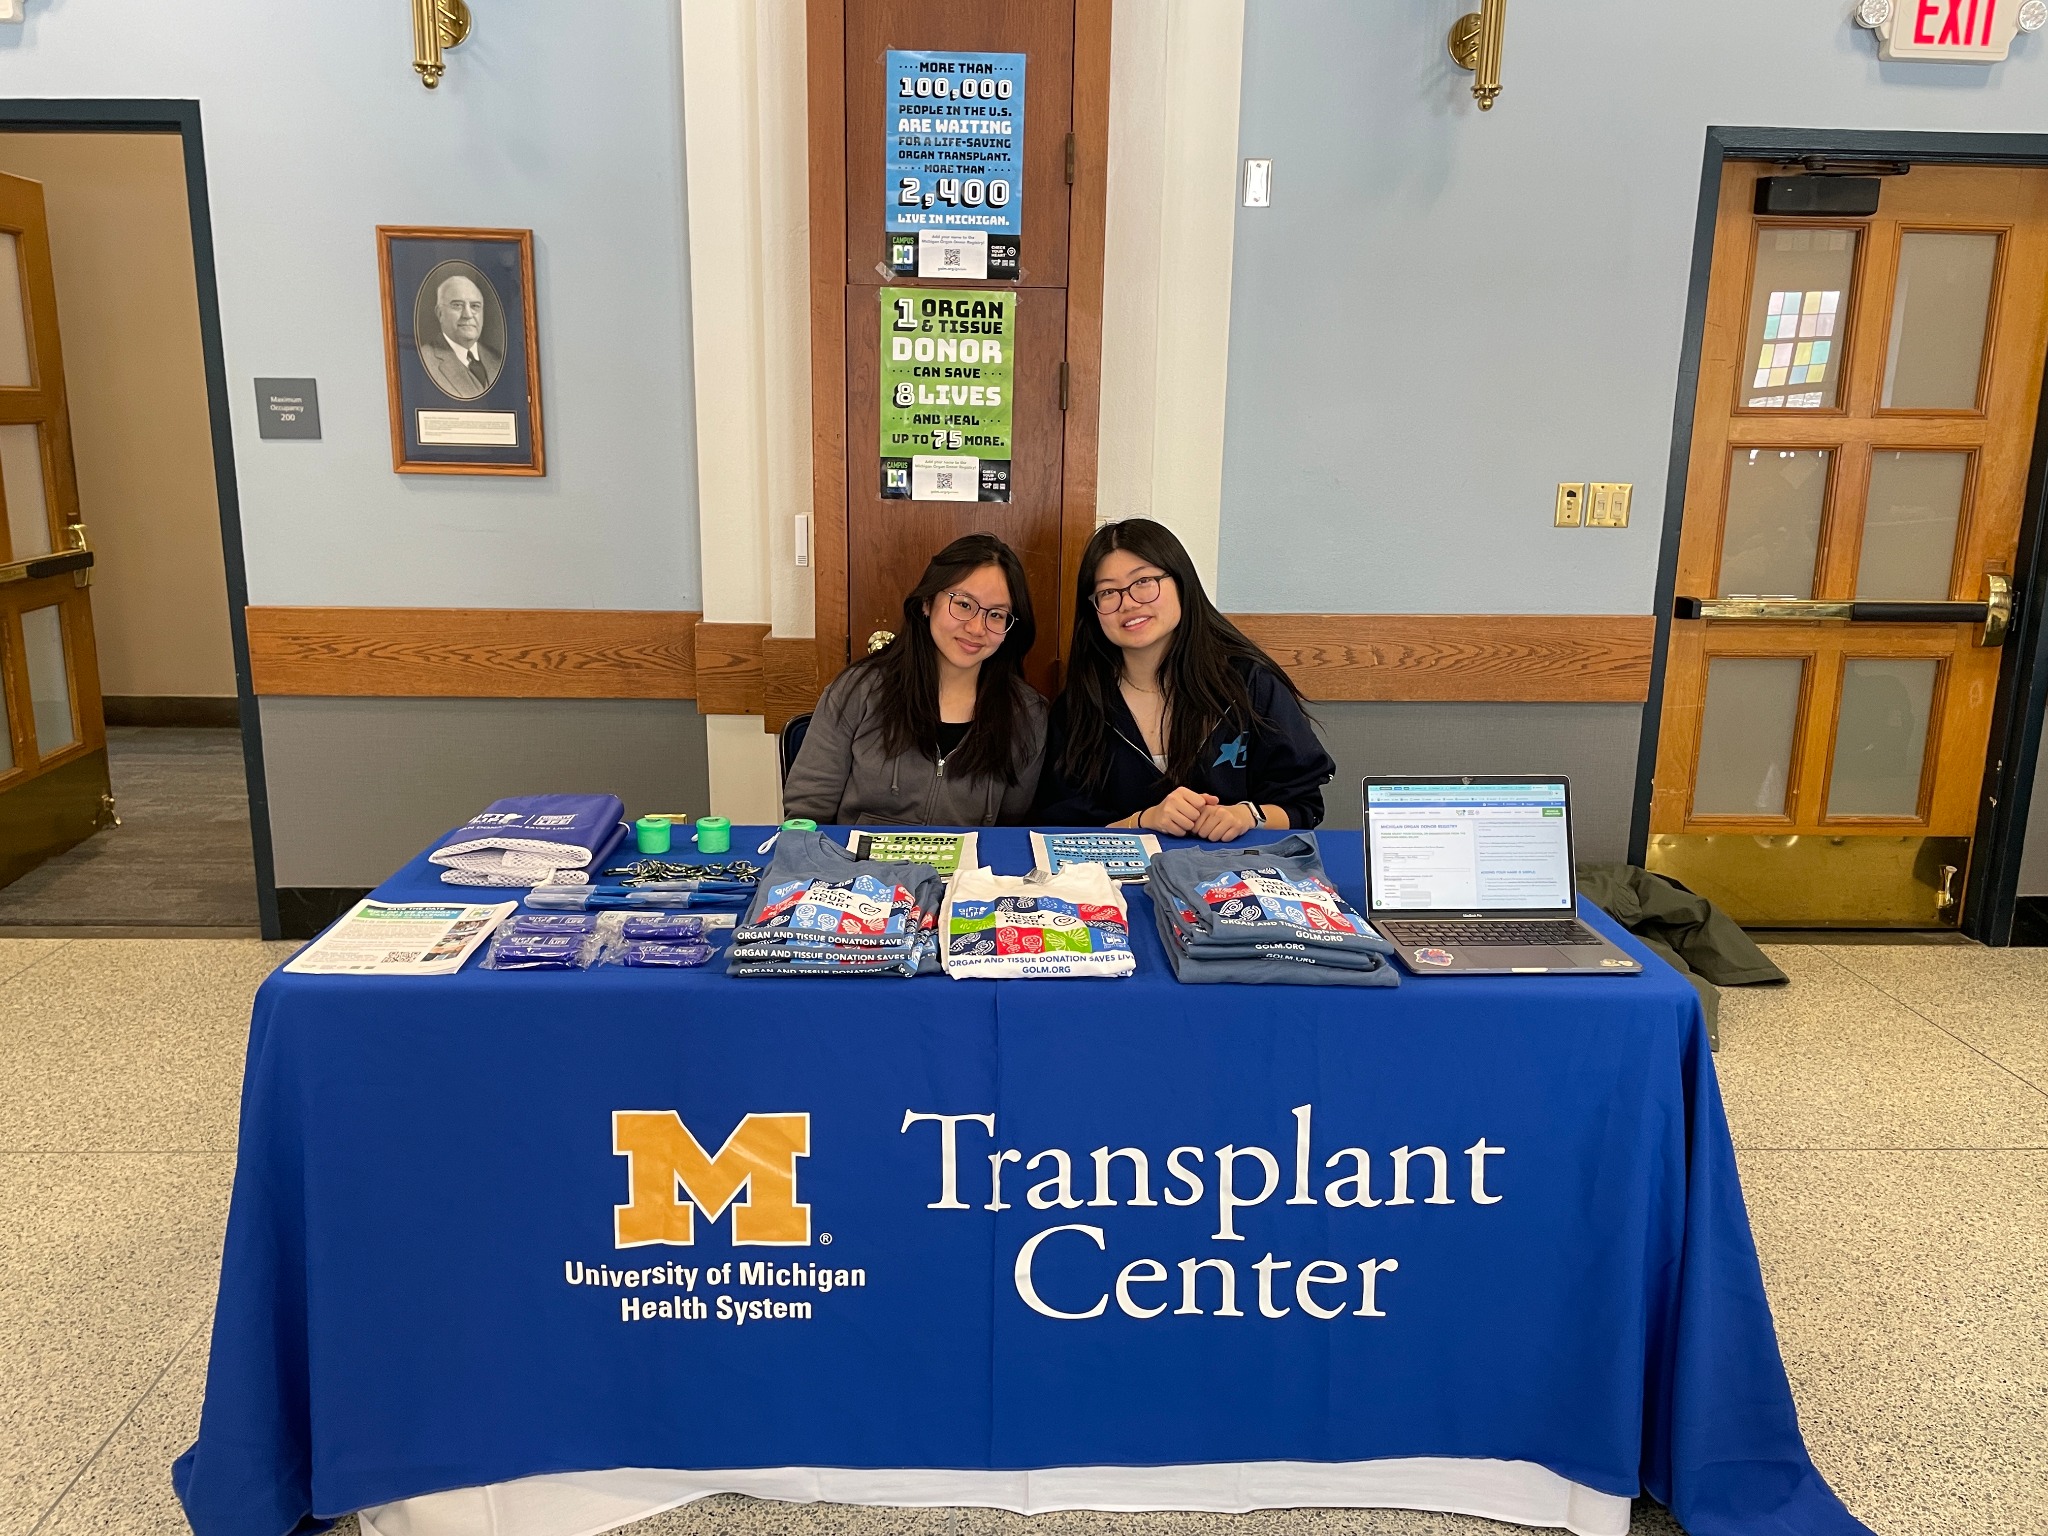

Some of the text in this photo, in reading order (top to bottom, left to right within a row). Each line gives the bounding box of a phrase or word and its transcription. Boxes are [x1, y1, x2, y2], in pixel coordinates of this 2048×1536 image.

[919, 62, 993, 74] MORE THAN
[900, 77, 1012, 101] 100,000
[899, 105, 1012, 116] PEOPLE IN THE U.S.
[898, 118, 1011, 134] ARE WAITING
[898, 137, 1011, 148] FOR A LIFE-SAVING
[898, 151, 1011, 161] ORGAN TRANSPLANT.
[924, 164, 985, 174] MORE THAN
[898, 177, 1010, 209] 2,400
[897, 213, 1010, 226] LIVE IN MICHIGAN.
[892, 236, 914, 244] CAMPUS
[893, 298, 1003, 332] 1 ORGAN
[922, 320, 1003, 334] & TISSUE
[892, 337, 1002, 364] DONOR
[913, 367, 981, 378] CAN SAVE
[893, 382, 1001, 408] 8 LIVES
[281, 413, 296, 421] 200
[913, 414, 980, 426] AND HEAL
[892, 429, 1005, 450] UP TO 75 MORE.
[887, 461, 908, 469] CAMPUS
[870, 843, 956, 851] DONOR
[812, 889, 854, 900] CHECK
[813, 892, 845, 903] YOUR
[809, 896, 852, 909] HEART
[1220, 918, 1255, 927] ORGAN
[737, 931, 771, 940] ORGAN
[773, 931, 794, 939] AND
[795, 932, 826, 942] TISSUE
[828, 937, 877, 946] DONATION
[1295, 930, 1344, 942] GOLM.ORG
[1255, 942, 1306, 951] GOLM.ORG
[733, 949, 905, 961] ORGAN AND TISSUE DONATION SAVES
[949, 957, 982, 967] ORGAN
[1039, 954, 1087, 963] DONATION
[1089, 954, 1116, 963] SAVES
[1118, 953, 1134, 961] LIV
[1022, 965, 1071, 974] GOLM.ORG
[900, 1103, 1506, 1241] Transplant
[611, 1109, 811, 1250] M
[564, 1260, 866, 1293] University of Michigan
[1014, 1224, 1399, 1320] Center
[621, 1295, 813, 1326] Health System
